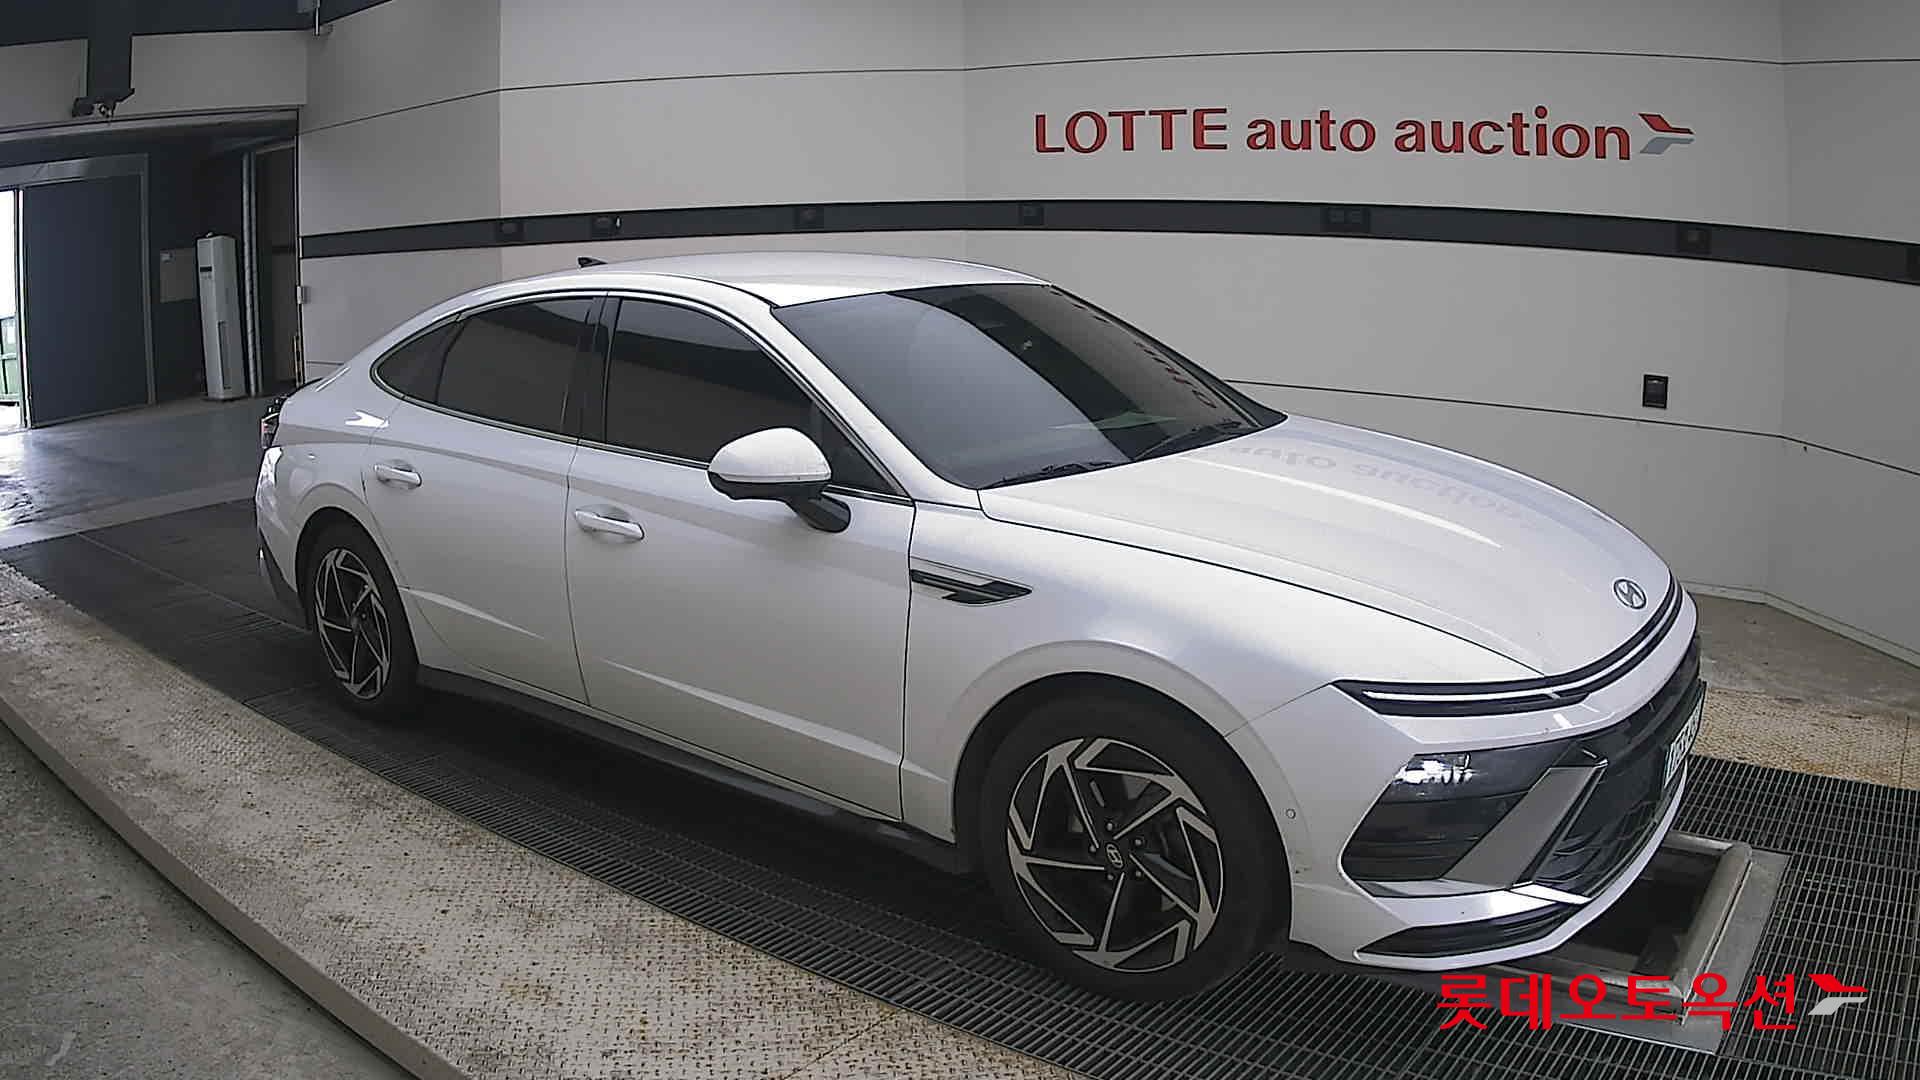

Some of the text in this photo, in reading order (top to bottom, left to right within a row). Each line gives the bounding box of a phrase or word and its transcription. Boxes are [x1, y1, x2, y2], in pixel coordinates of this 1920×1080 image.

[1034, 105, 1631, 160] LOTTE auto auction
